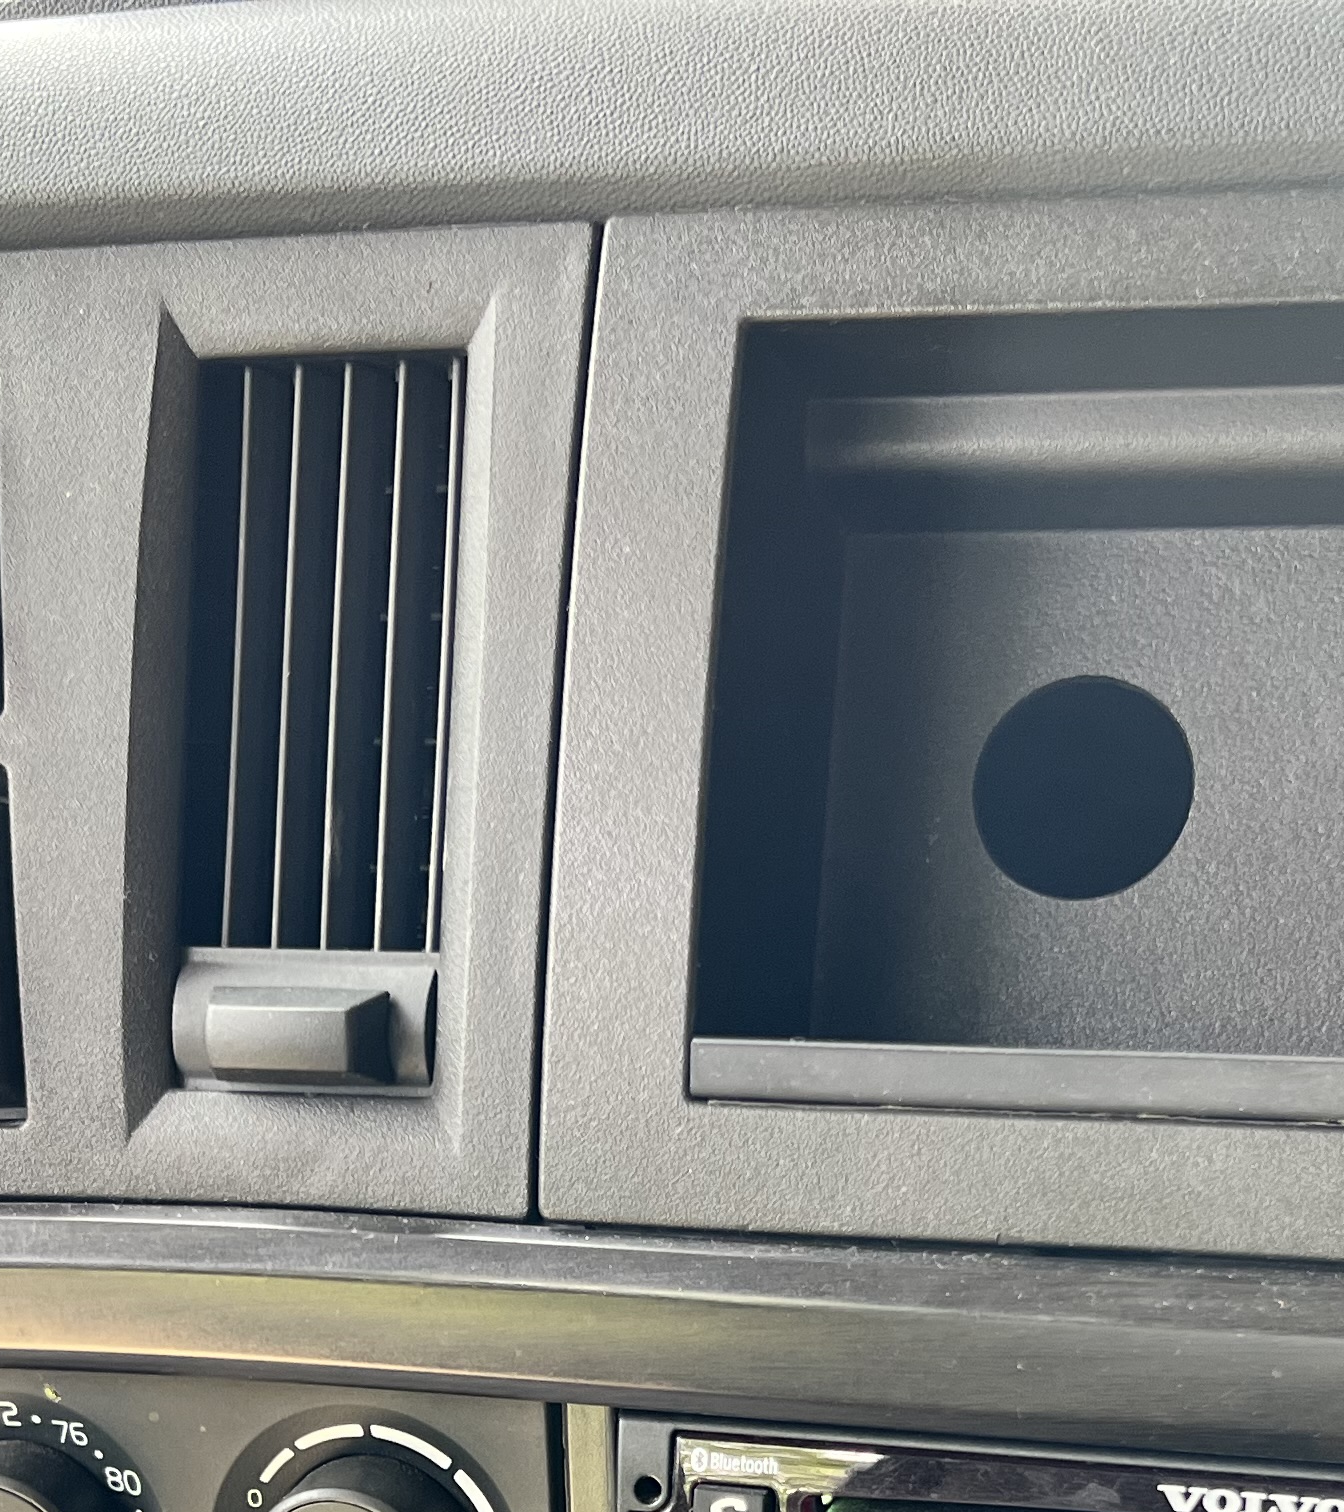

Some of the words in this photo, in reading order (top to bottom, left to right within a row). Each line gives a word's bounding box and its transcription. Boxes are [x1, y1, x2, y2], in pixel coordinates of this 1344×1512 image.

[51, 1420, 88, 1446] 76
[710, 1452, 778, 1475] Bluetooth
[105, 1467, 142, 1496] 80
